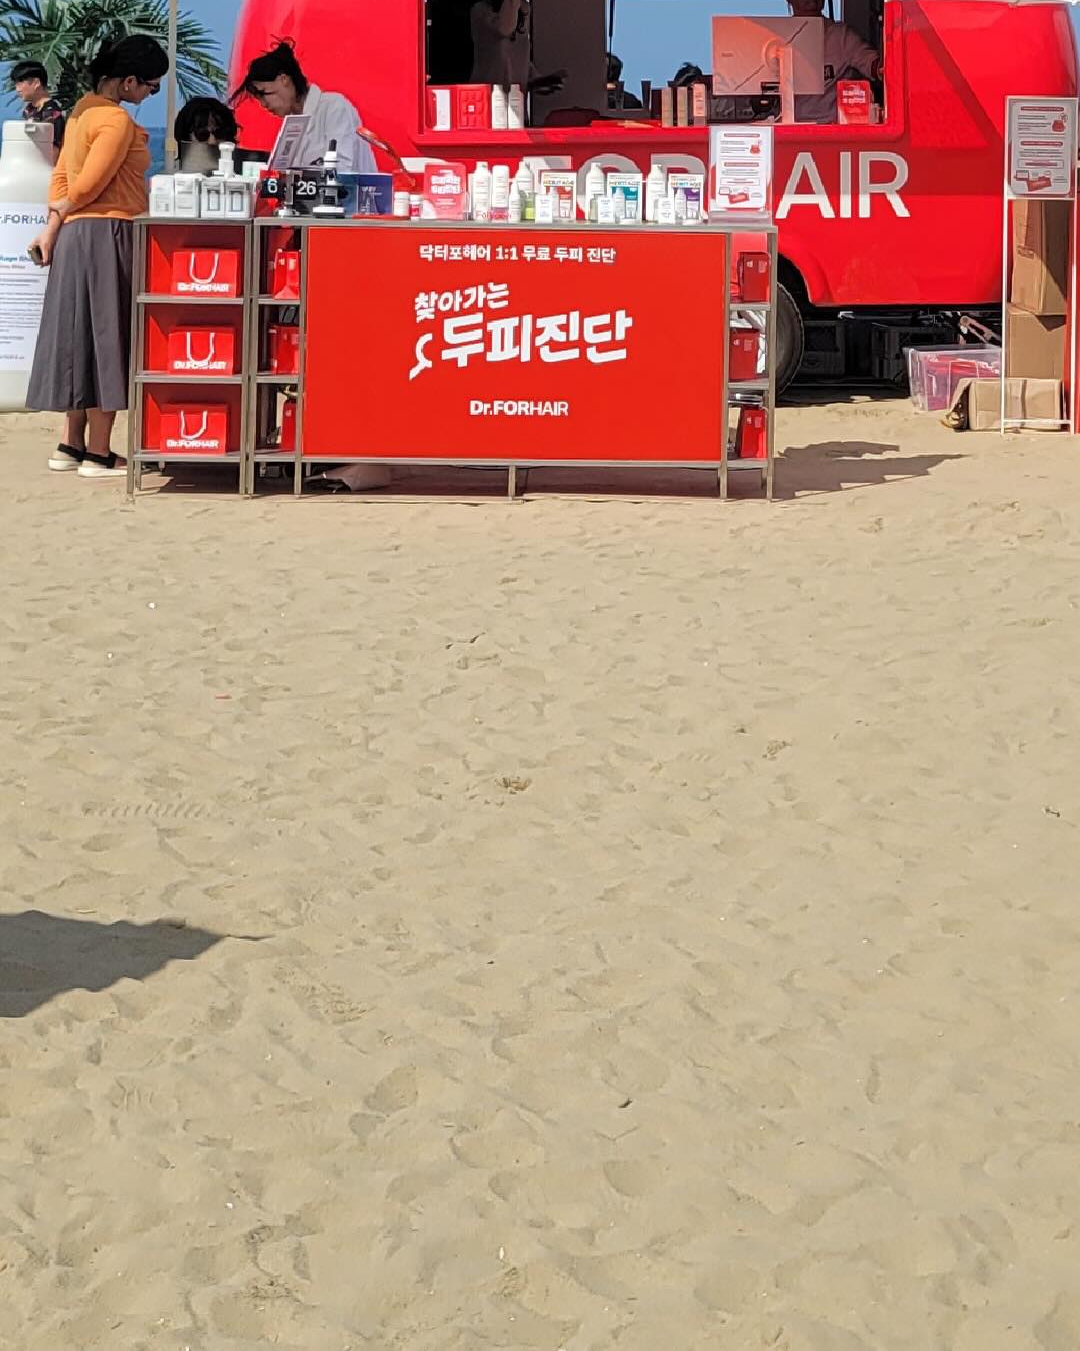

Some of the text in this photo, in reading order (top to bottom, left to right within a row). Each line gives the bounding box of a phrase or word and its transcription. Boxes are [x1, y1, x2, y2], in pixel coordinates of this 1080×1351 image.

[267, 178, 279, 194] 6
[296, 180, 317, 196] 26
[419, 244, 617, 264] 닥터포헤어 1:1 무료 두피 진단
[415, 282, 510, 323] 찾아가는
[441, 309, 633, 368] 두피진단
[469, 400, 569, 416] Dr.FORHAIR
